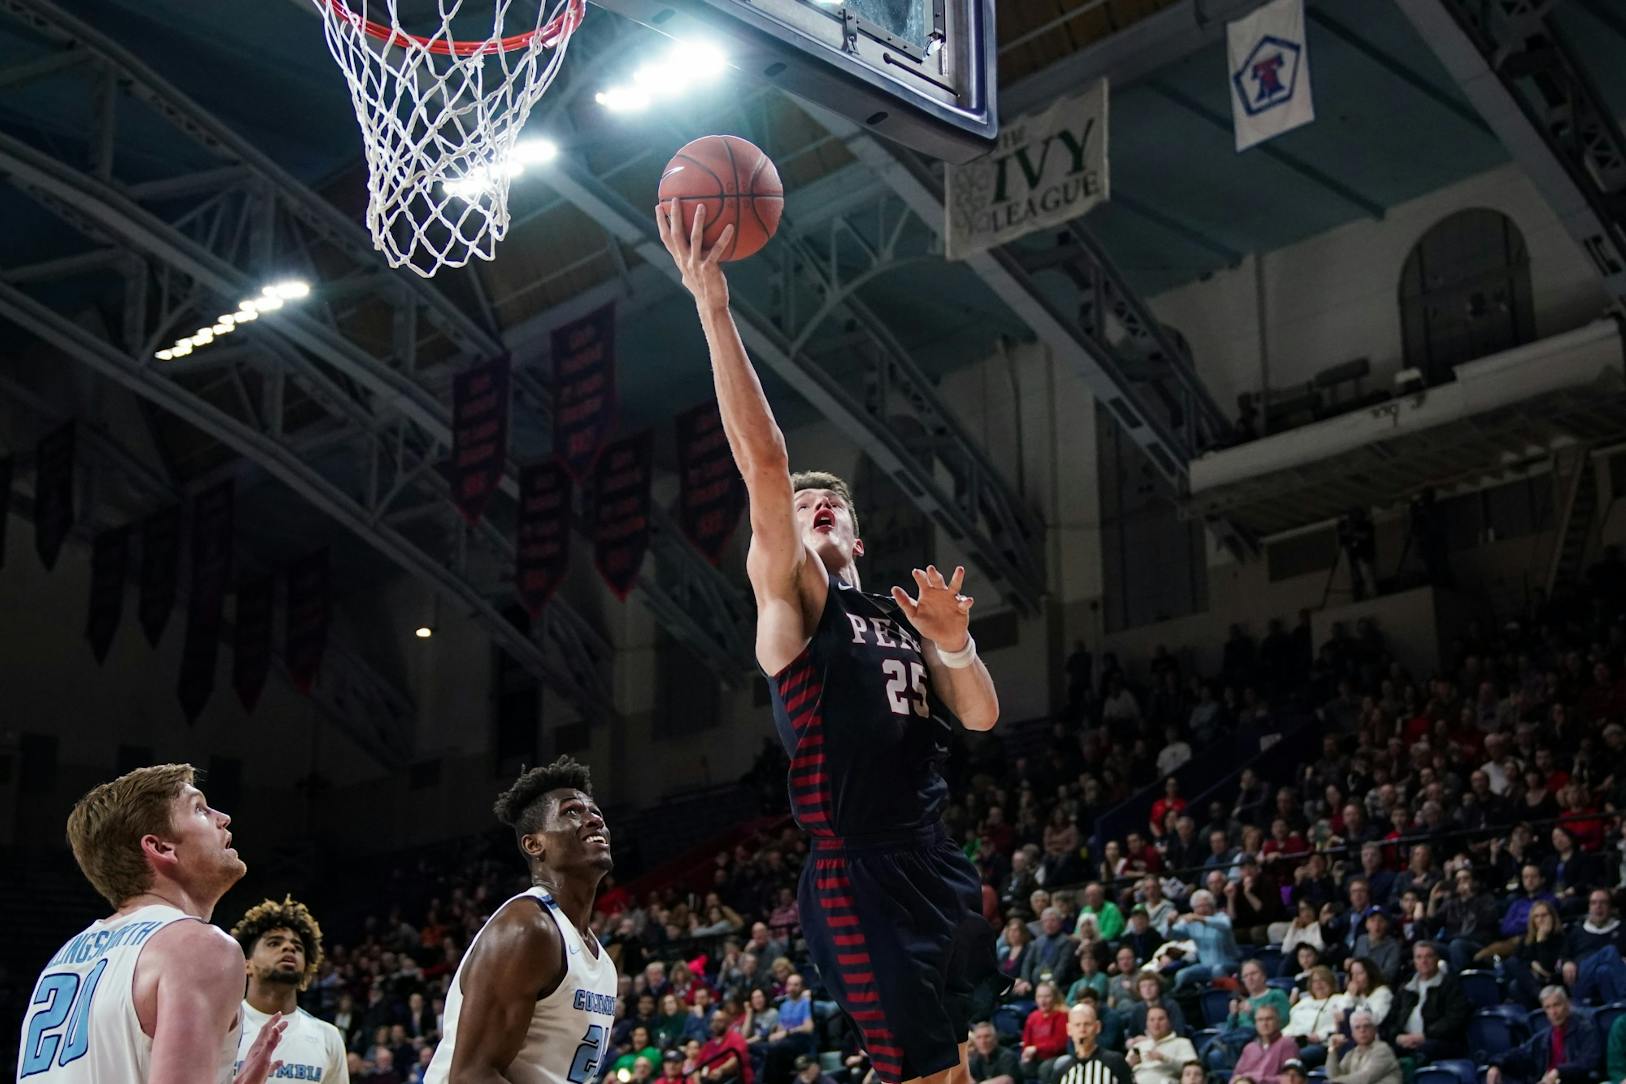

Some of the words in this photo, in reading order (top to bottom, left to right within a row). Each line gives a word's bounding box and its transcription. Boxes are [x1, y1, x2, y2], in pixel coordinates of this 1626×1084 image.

[991, 117, 1095, 204] IVY
[992, 170, 1100, 233] LEAGUE
[881, 658, 930, 719] 25
[20, 958, 109, 1080] 20
[567, 1024, 609, 1084] 2
